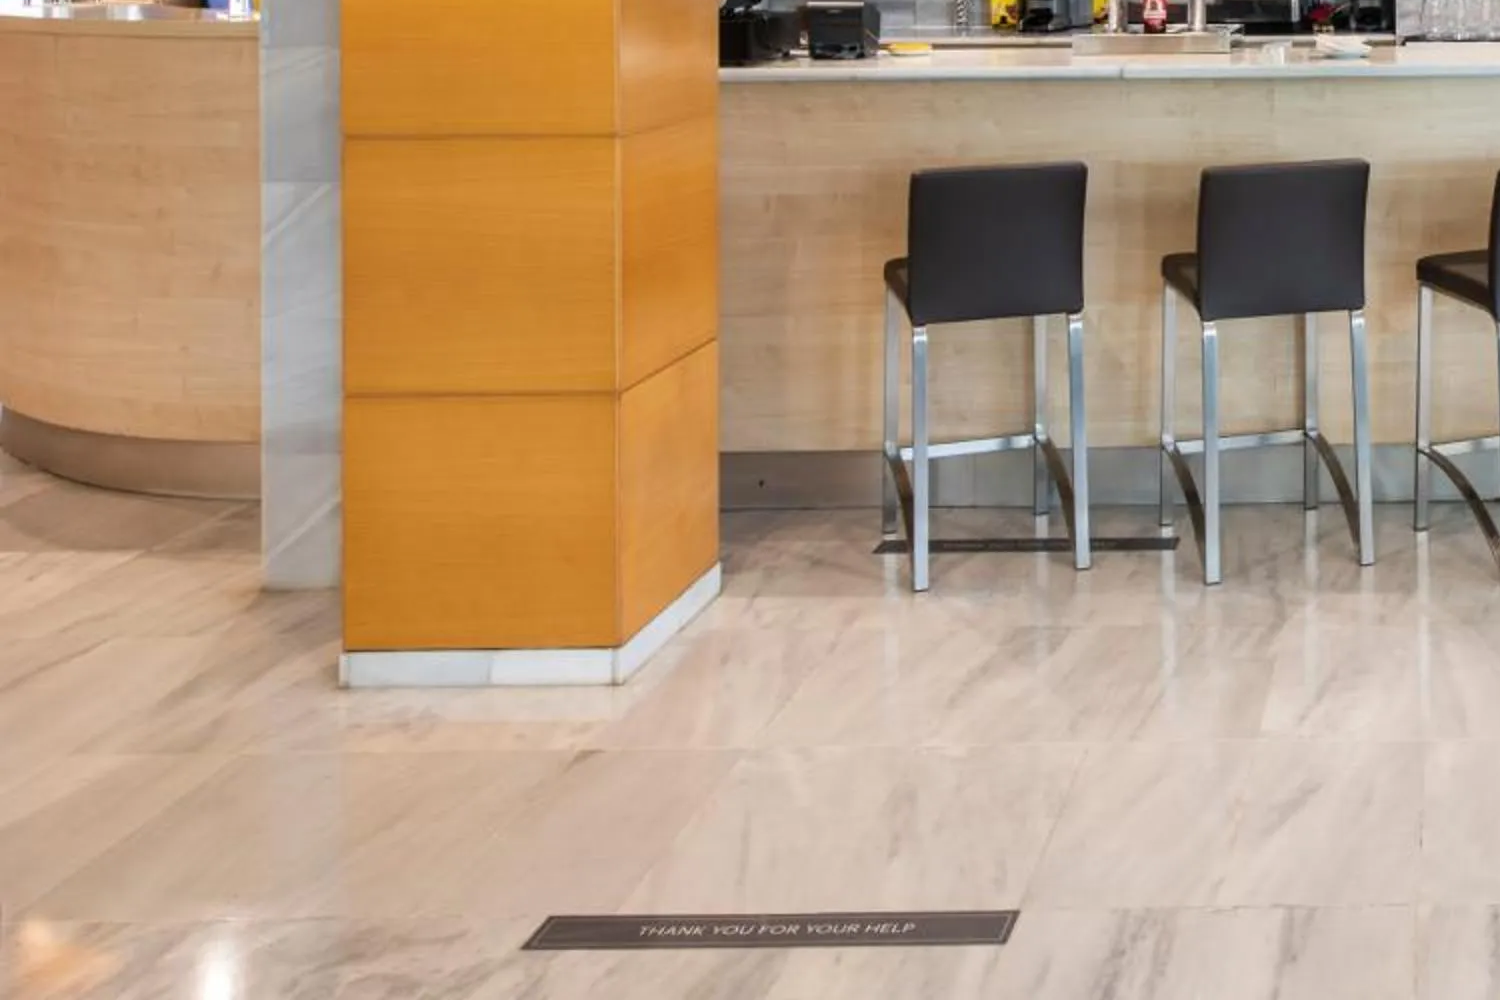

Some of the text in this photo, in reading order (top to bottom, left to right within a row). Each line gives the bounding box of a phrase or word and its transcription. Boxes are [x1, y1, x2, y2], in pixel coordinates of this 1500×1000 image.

[639, 922, 917, 936] THANK YOU FOR YOUR HELP
